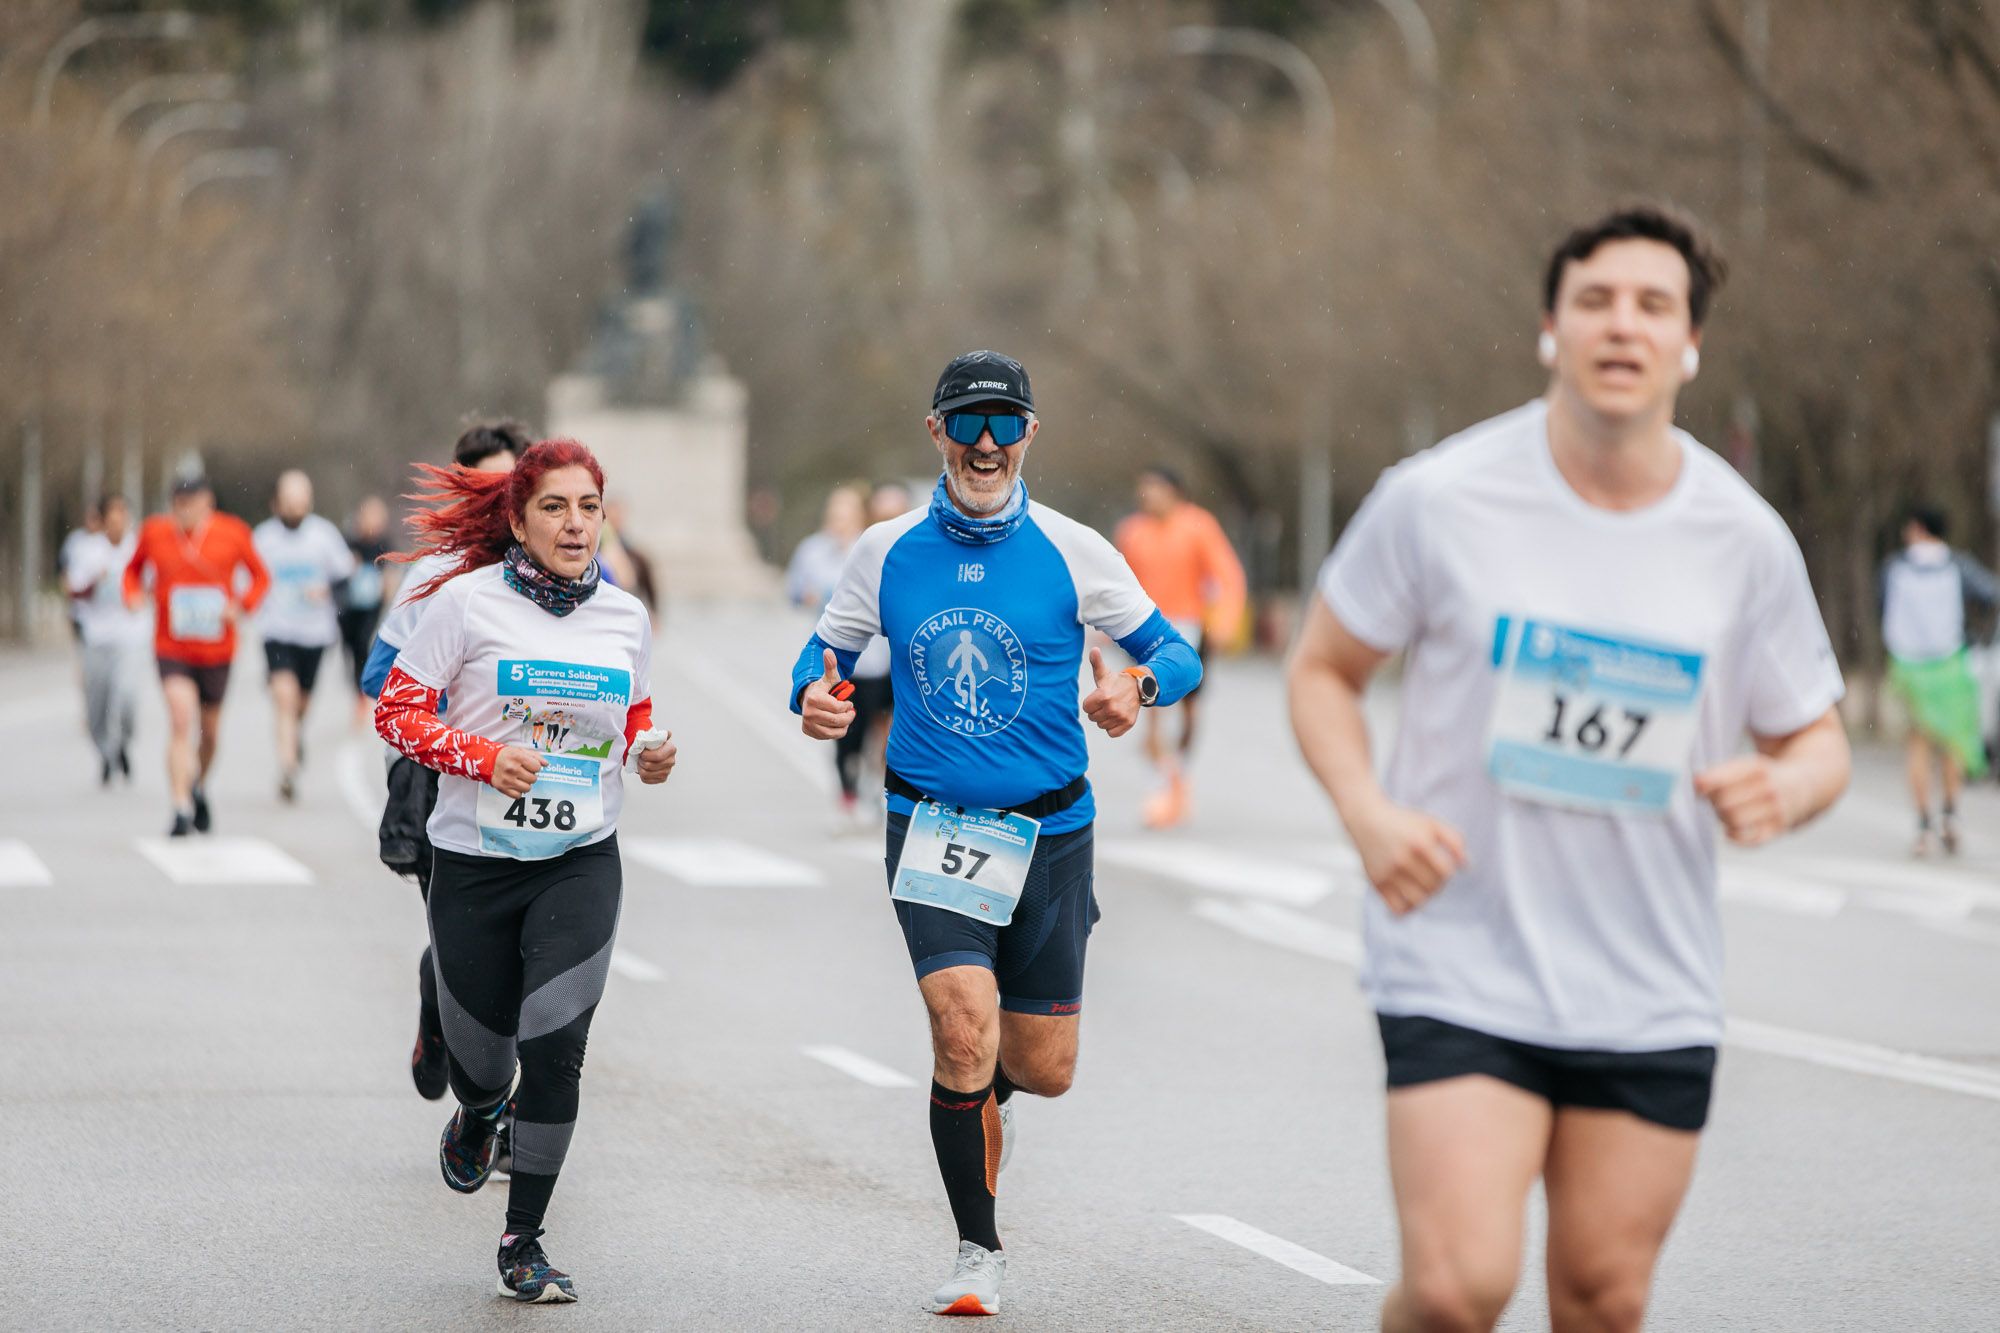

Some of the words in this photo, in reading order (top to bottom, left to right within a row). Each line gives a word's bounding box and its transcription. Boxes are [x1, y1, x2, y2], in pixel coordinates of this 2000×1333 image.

[977, 380, 1008, 391] TERREX
[919, 612, 968, 641] TRAIL
[973, 613, 1024, 693] PEÑALARA
[526, 667, 566, 678] Carrera
[567, 669, 609, 682] Solidaria
[913, 643, 932, 696] GRAN
[535, 687, 561, 695] Sábado
[597, 691, 626, 706] 2026
[952, 715, 999, 733] 2015
[1546, 697, 1648, 757] 167
[545, 763, 582, 776] Solidaria
[503, 796, 577, 831] 438
[978, 816, 1018, 833] Solidaria
[941, 842, 991, 880] 57
